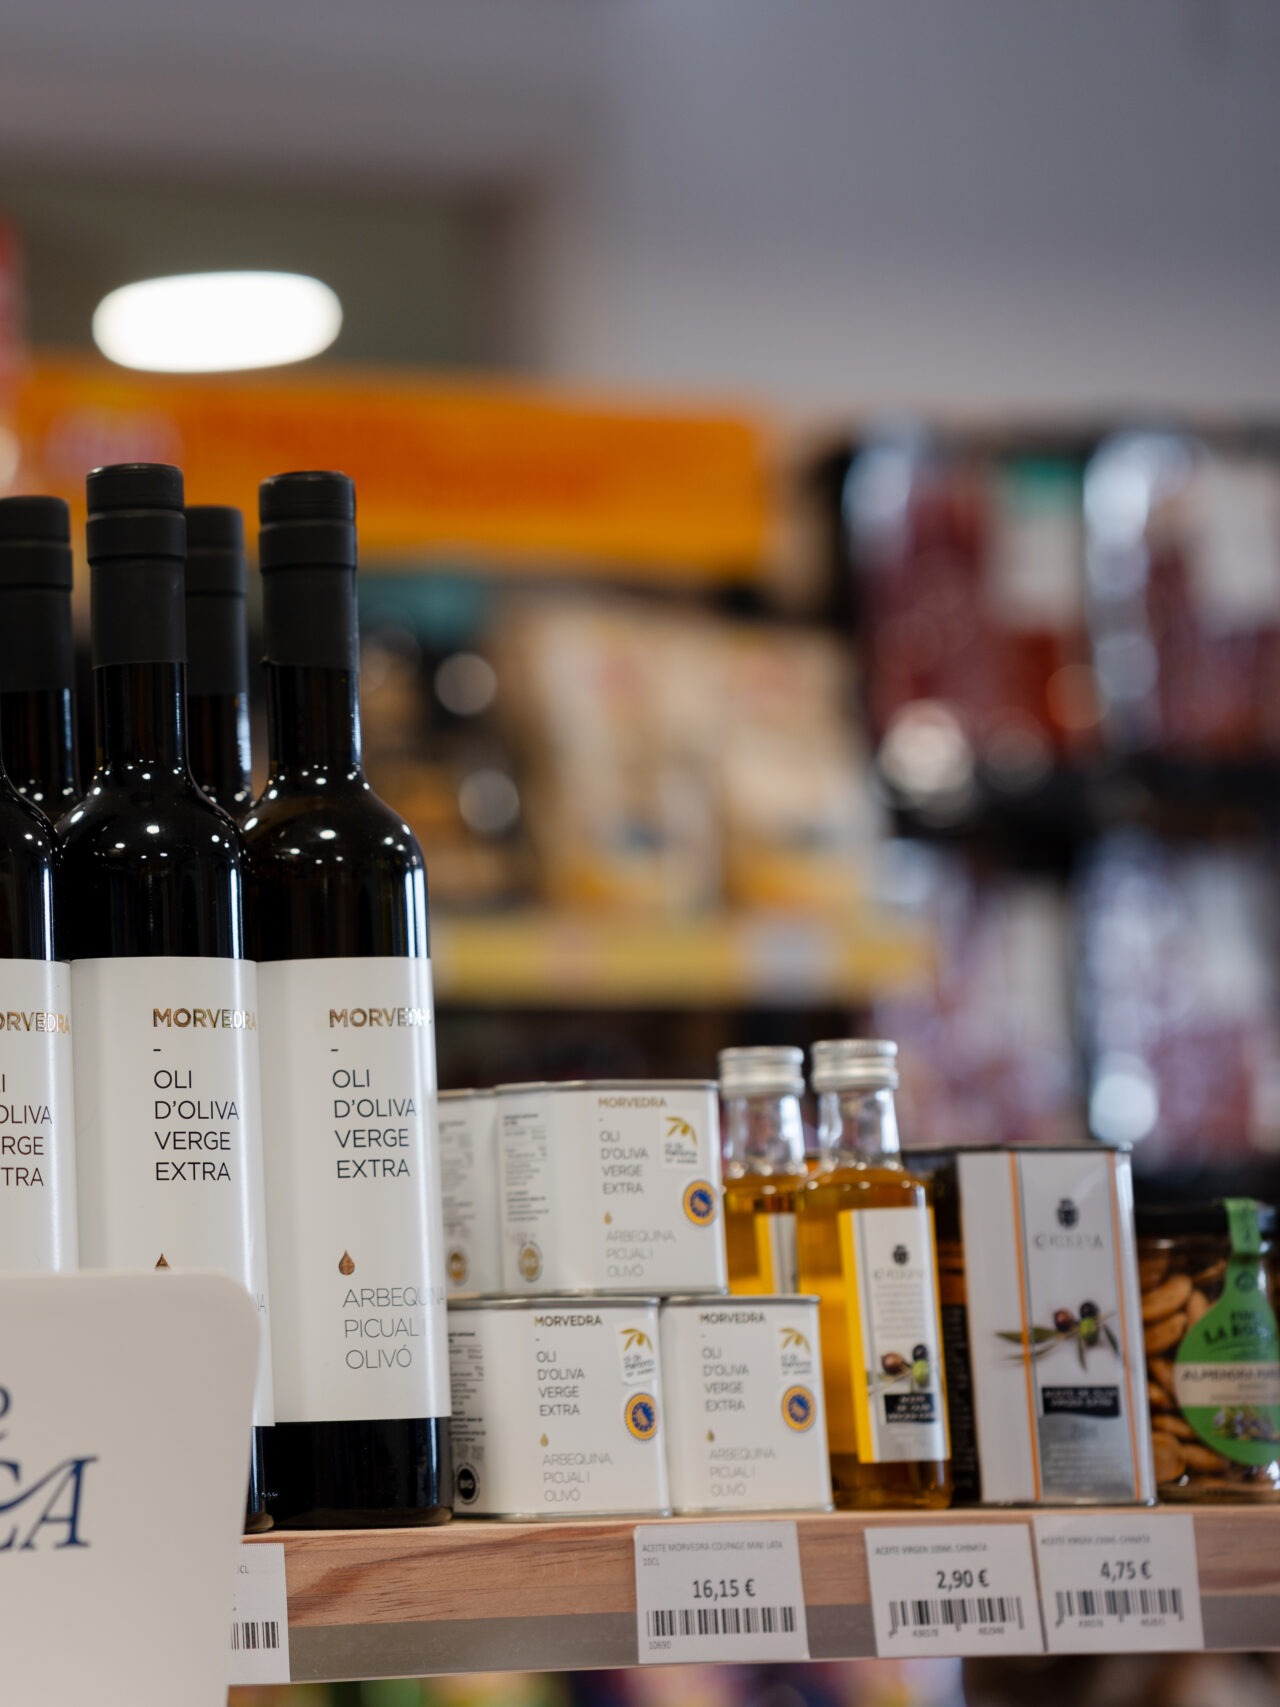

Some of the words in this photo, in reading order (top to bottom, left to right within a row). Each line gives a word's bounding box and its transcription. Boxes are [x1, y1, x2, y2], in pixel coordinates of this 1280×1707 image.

[153, 1008, 256, 1031] MORVEDRA
[153, 1070, 192, 1089] OLI
[332, 1069, 370, 1088] OLI
[334, 1098, 417, 1118] D'OLIVA
[598, 1096, 667, 1109] MORVEDRA
[154, 1100, 239, 1120] D'OLIVA
[154, 1131, 231, 1151] VERGE
[335, 1128, 409, 1148] VERGE
[600, 1130, 620, 1144] OLI
[601, 1147, 648, 1161] D'OLIVA
[155, 1162, 231, 1181] EXTRA
[337, 1159, 411, 1179] EXTRA
[603, 1164, 644, 1178] VERGE
[603, 1181, 644, 1196] EXTRA
[534, 1314, 603, 1328] MORVEDRA
[699, 1312, 767, 1325] MORVEDRA
[344, 1318, 420, 1339] PICUAL
[345, 1344, 412, 1369] OLIVÓ
[537, 1350, 557, 1364] OLI
[702, 1346, 722, 1360] OLI
[538, 1368, 585, 1382] D'OLIVA
[703, 1363, 749, 1377] D'OLIVA
[539, 1386, 580, 1399] VERGE
[704, 1381, 745, 1395] VERGE
[540, 1403, 581, 1417] EXTRA
[706, 1399, 745, 1412] EXTRA
[642, 1543, 667, 1552] ACEITE
[668, 1542, 710, 1552] MORVEDRA
[711, 1541, 745, 1551] COUPAGE
[747, 1541, 764, 1550] MINI
[766, 1540, 783, 1550] LATA
[1100, 1561, 1136, 1582] 4,75
[1140, 1560, 1152, 1579] €
[936, 1570, 974, 1592] 2,90
[978, 1569, 990, 1588] €
[693, 1578, 740, 1601] 16,15
[745, 1578, 756, 1597] €
